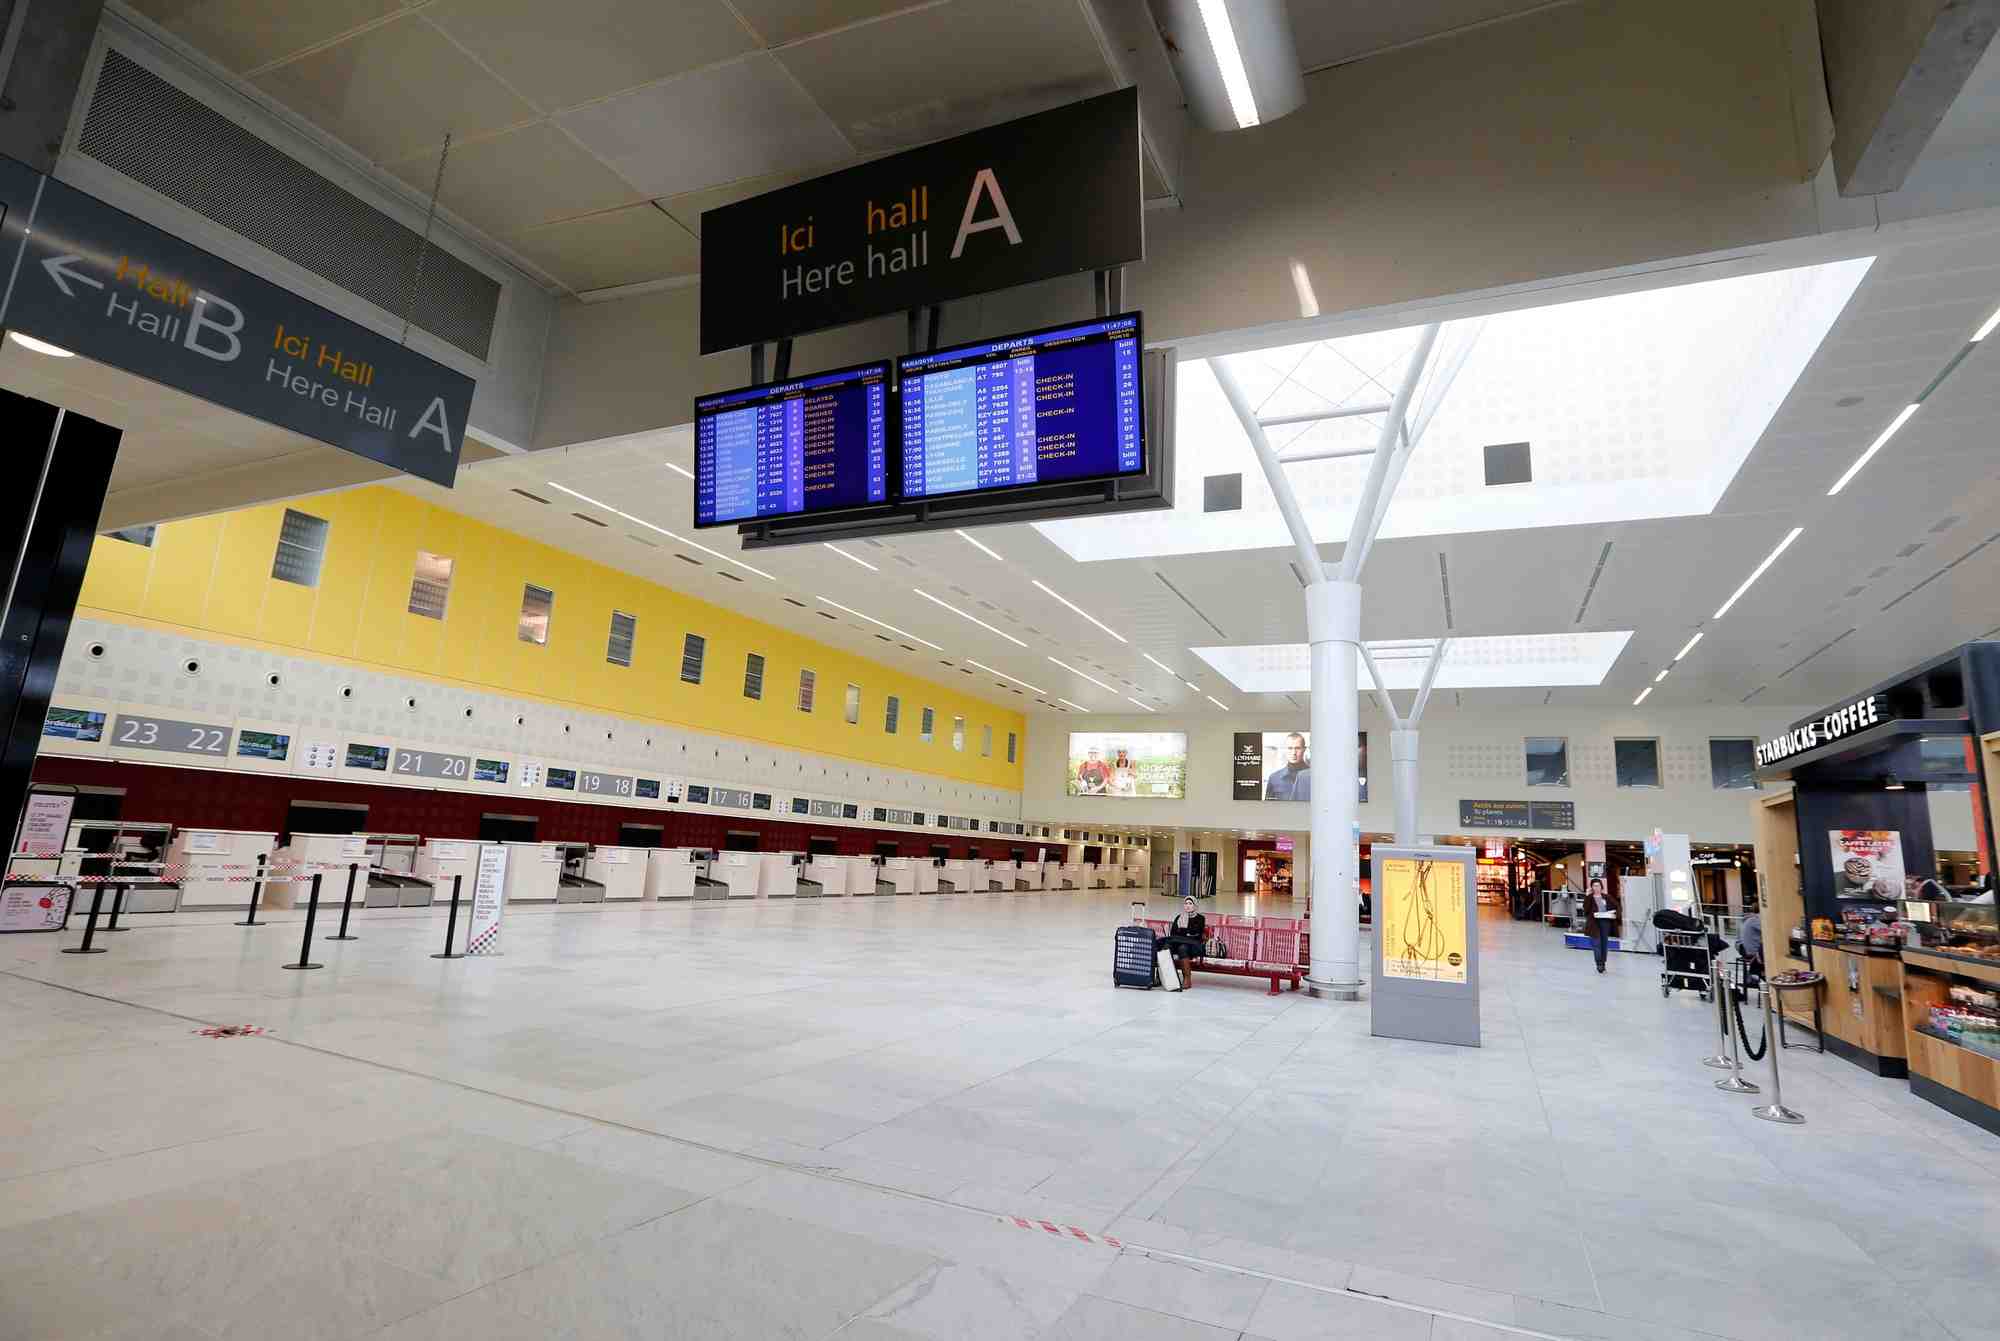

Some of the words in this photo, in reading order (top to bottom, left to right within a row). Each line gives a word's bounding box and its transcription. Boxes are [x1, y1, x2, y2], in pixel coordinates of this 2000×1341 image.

[782, 215, 815, 255] Ici
[867, 186, 928, 235] hall
[950, 168, 1023, 259] A
[115, 255, 193, 307] Hall
[783, 260, 854, 299] Here
[867, 230, 928, 278] hall
[107, 292, 180, 342] Hall
[184, 289, 244, 362] B
[273, 324, 310, 360] Ici
[316, 344, 374, 387] Hall
[265, 358, 339, 407] Here
[344, 391, 397, 430] Hall
[408, 397, 452, 453] A
[120, 720, 159, 744] 23
[187, 728, 224, 752] 22
[1756, 723, 1817, 766] STARBUCKS
[1823, 696, 1878, 740] COFFEE
[400, 753, 422, 772] 21
[442, 758, 465, 777] 20
[583, 775, 600, 791] 19
[615, 779, 629, 794] 18
[714, 791, 728, 803] 17
[737, 793, 749, 807] 16
